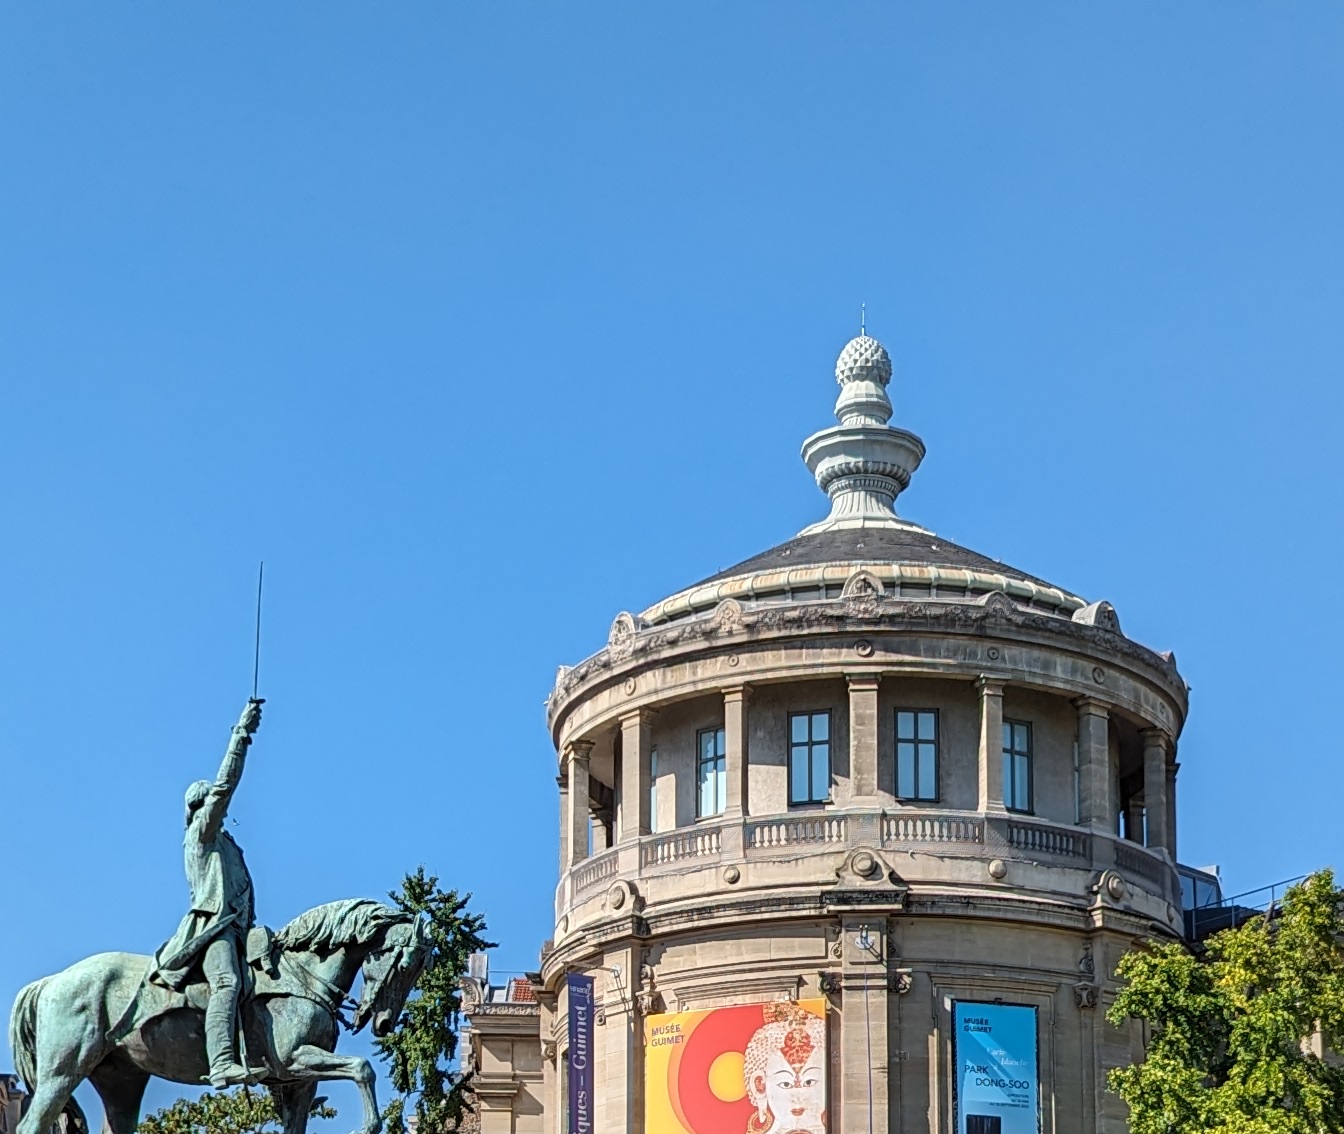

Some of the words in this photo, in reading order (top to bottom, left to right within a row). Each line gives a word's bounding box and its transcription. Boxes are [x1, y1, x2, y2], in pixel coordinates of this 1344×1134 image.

[651, 1023, 681, 1037] MUSÉE
[572, 1005, 588, 1070] Guimet
[651, 1034, 686, 1047] GUIMET
[964, 1064, 989, 1075] PARK
[975, 1077, 1030, 1090] DONG-SOO
